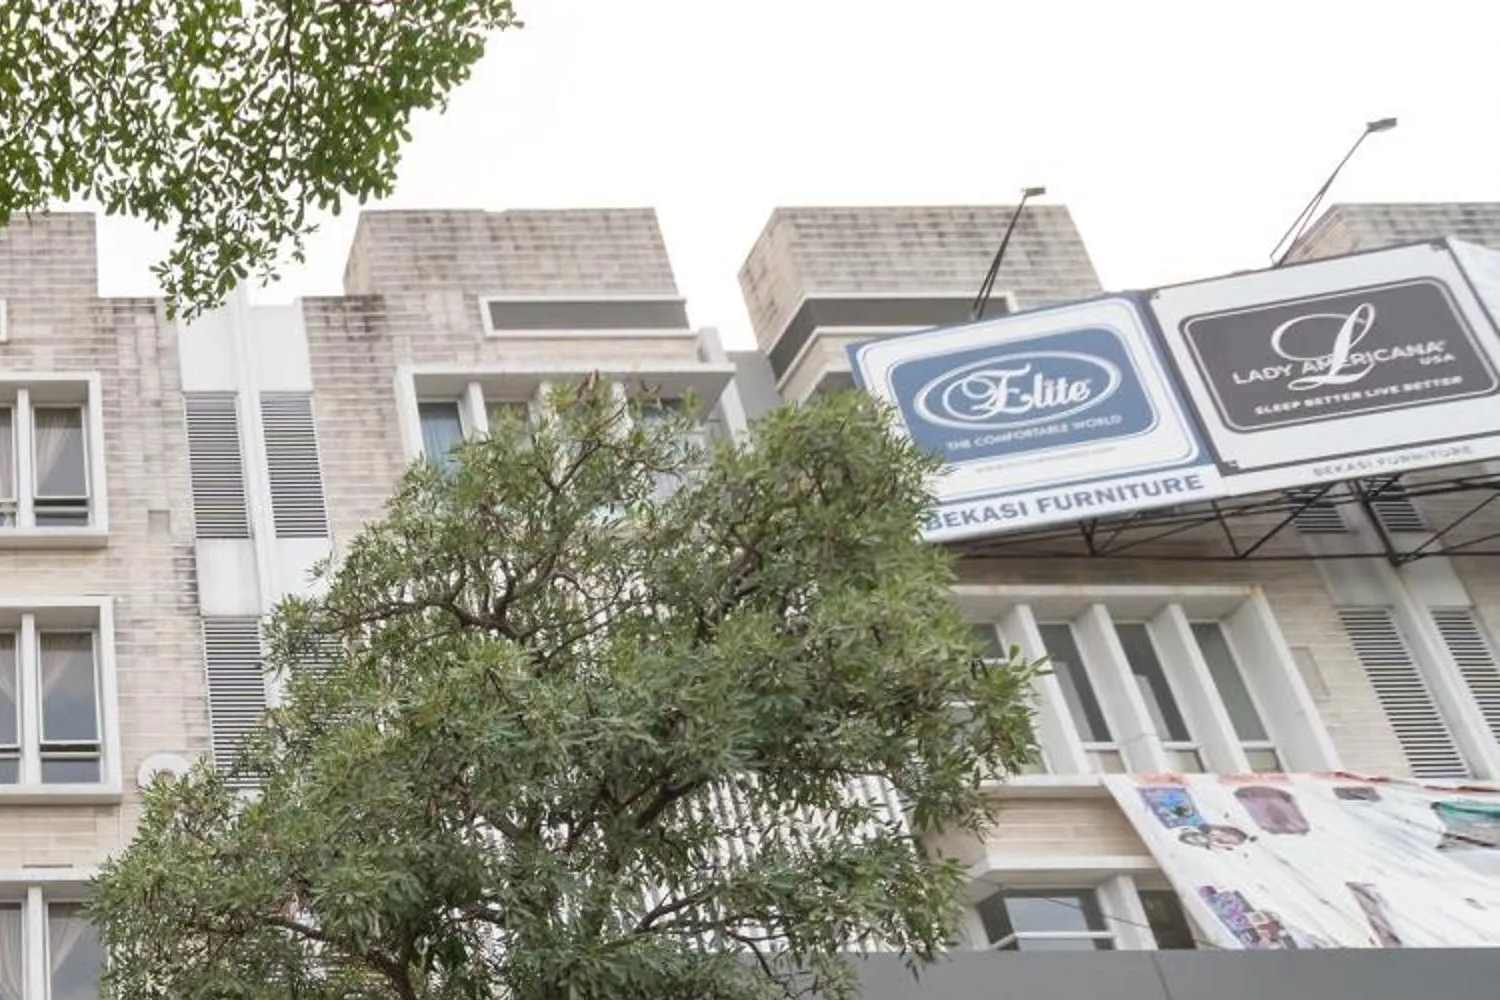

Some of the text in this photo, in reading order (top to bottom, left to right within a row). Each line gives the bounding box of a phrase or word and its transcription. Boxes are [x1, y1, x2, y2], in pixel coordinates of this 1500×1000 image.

[1232, 340, 1446, 385] LADY AMRICANA
[1419, 353, 1456, 366] USA
[942, 362, 1093, 421] Elite
[1254, 375, 1464, 415] SLEEP BETTER LIVE BETTER
[948, 413, 1123, 450] THE COMFORTABLE WORLD
[926, 474, 1205, 532] BEKASI FURNITURE
